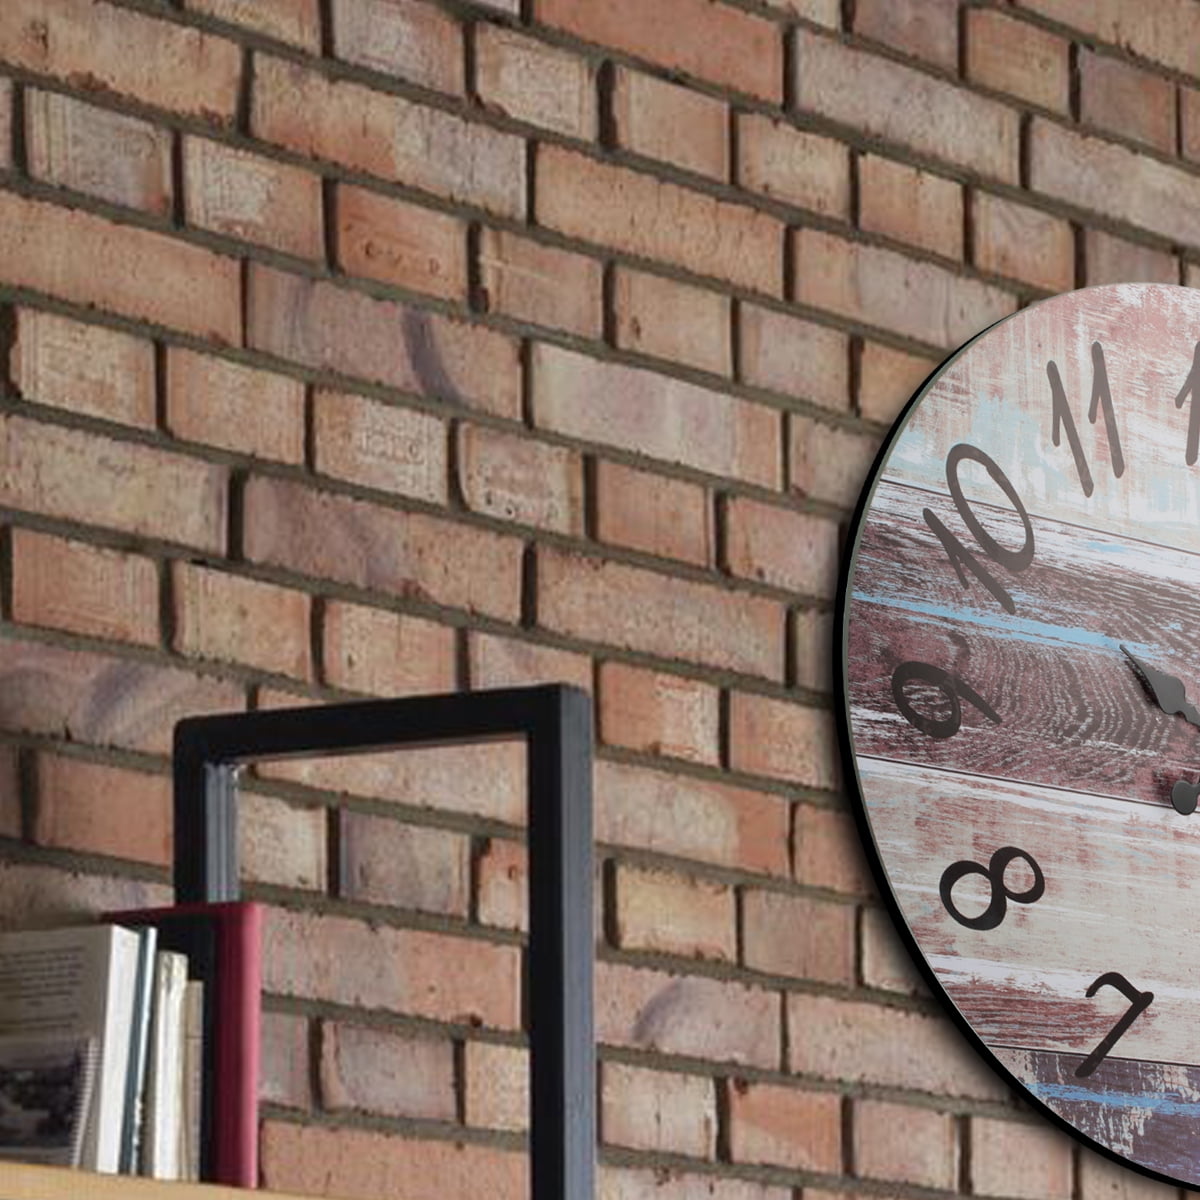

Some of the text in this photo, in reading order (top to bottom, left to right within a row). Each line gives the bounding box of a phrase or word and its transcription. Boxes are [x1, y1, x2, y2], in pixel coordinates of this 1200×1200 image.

[1046, 341, 1125, 498] 11
[923, 442, 1035, 615] 10
[892, 661, 1003, 739] 9
[939, 846, 1045, 931] 8
[1074, 972, 1154, 1078] 7
